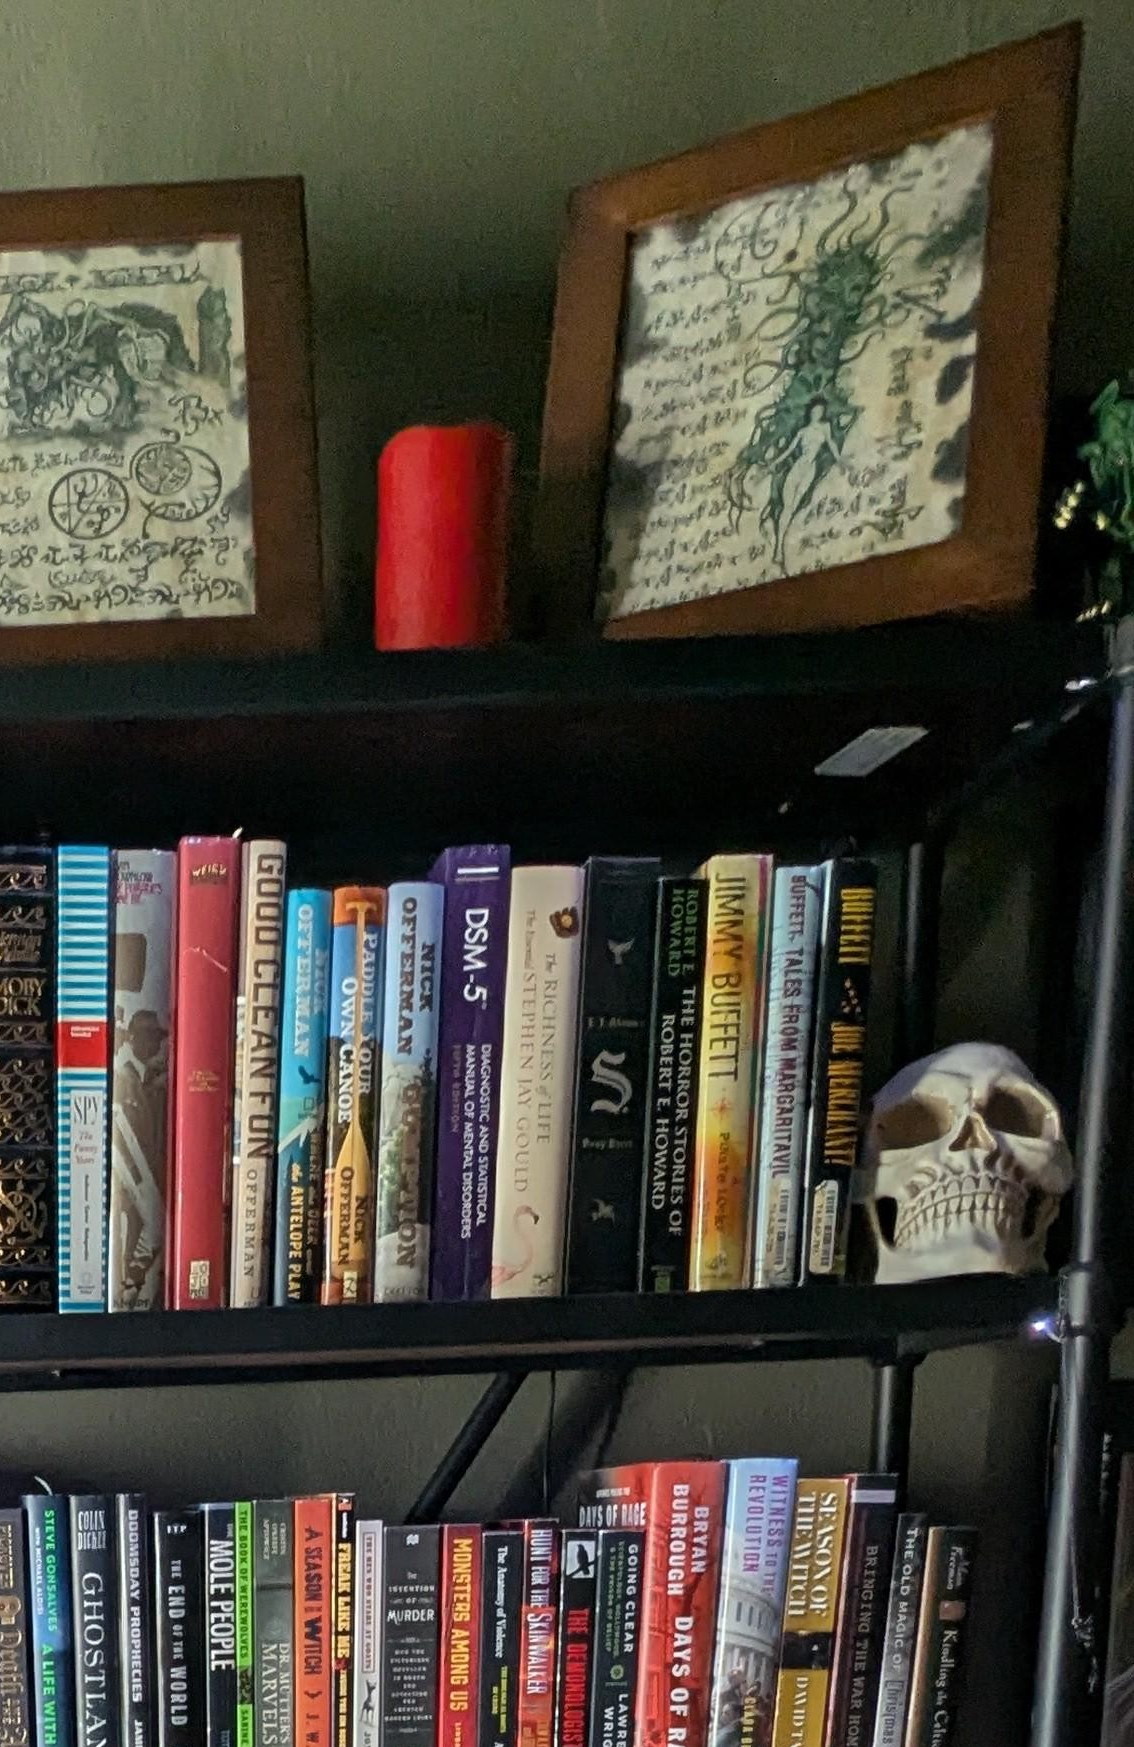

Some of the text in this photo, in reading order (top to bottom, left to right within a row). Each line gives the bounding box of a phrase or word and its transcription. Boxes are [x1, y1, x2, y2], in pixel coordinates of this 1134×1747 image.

[247, 854, 283, 1159] GOOD CLEAN FUN
[396, 896, 418, 1055] OFFERMAN
[462, 908, 489, 1003] DSM-5
[709, 873, 746, 1081] JIMMY BUFFETT
[670, 1029, 693, 1213] HORROR STORIES
[243, 1169, 258, 1277] OFFERMAN
[623, 1544, 639, 1653] GOING CLEAR
[667, 1483, 689, 1597] BURROUGH
[690, 1506, 709, 1574] BRYAN
[127, 1509, 144, 1703] DOOMSDAY PROPHECIES
[209, 1539, 236, 1671] MOLE PEOPLE
[449, 1538, 472, 1712] MONSTERS AMONG US
[670, 1616, 694, 1678] DAYS
[670, 1687, 689, 1716] OF
